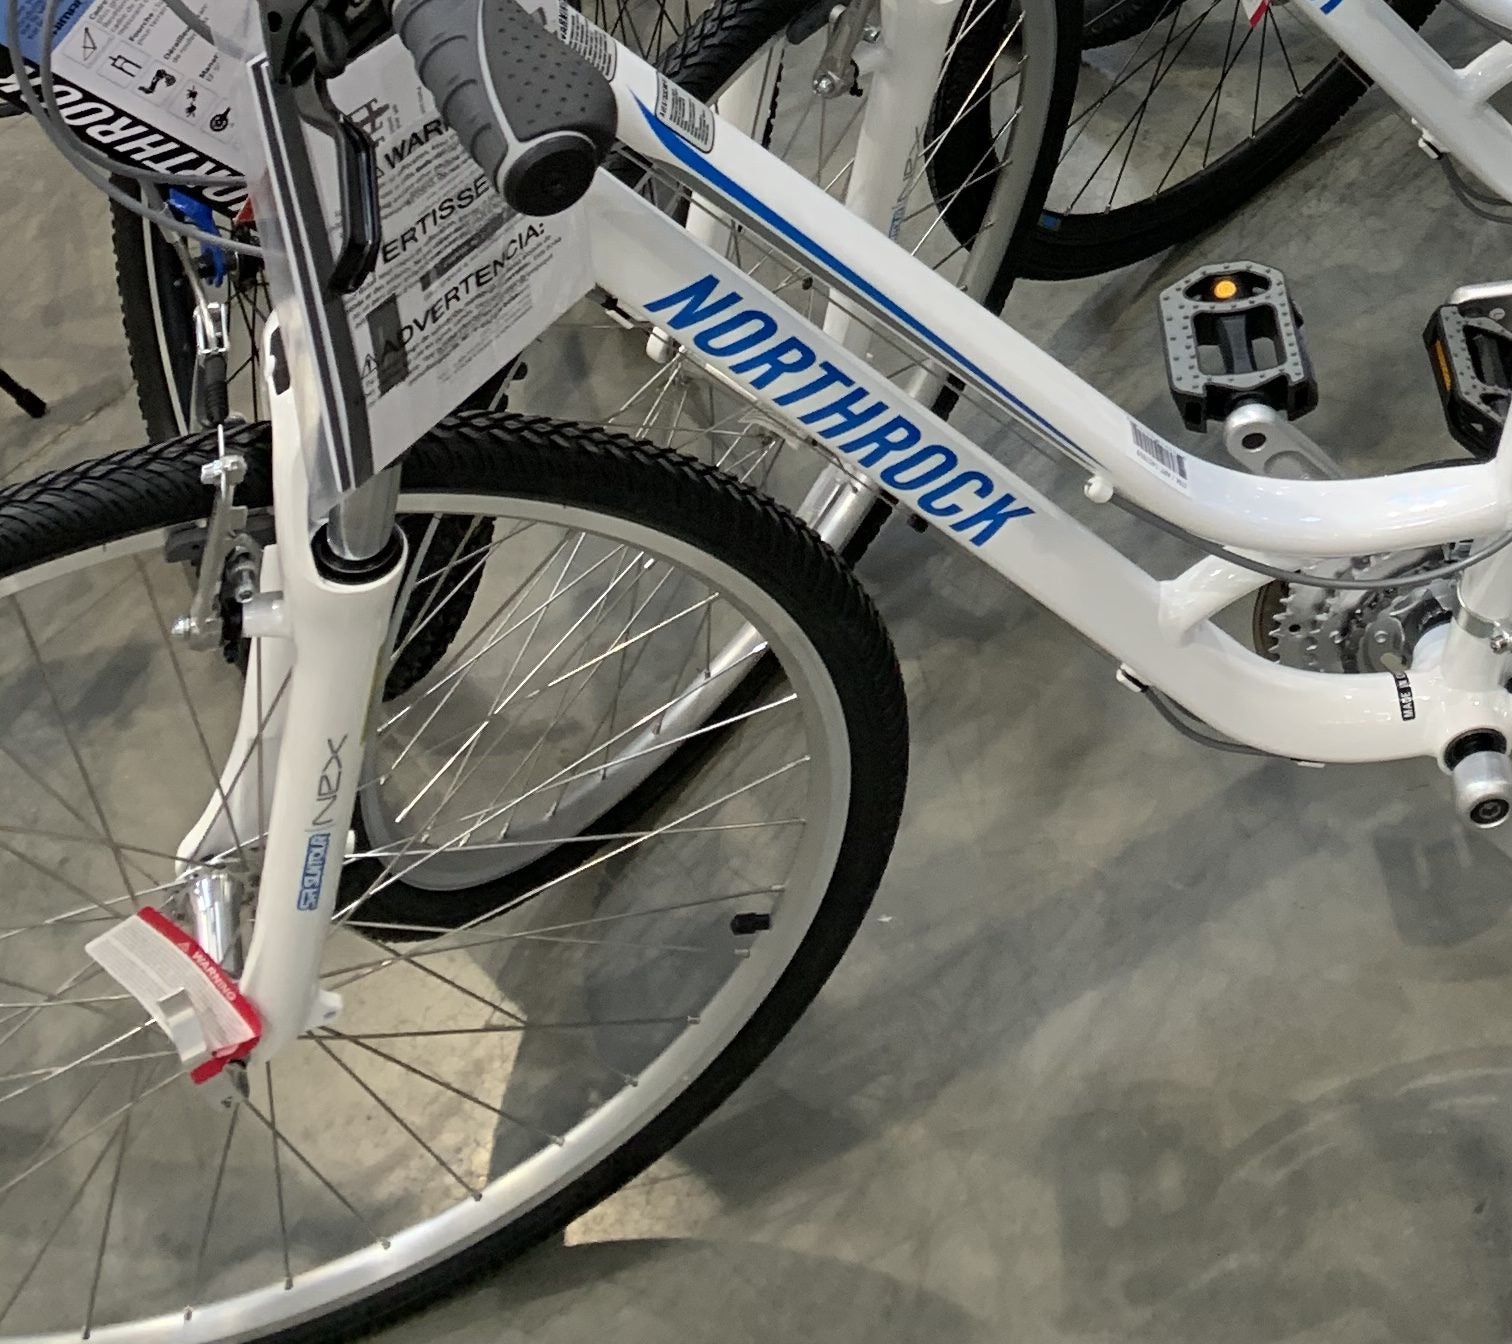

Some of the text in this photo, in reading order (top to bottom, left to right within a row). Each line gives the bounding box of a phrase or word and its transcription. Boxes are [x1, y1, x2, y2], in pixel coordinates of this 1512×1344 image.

[381, 171, 491, 265] ERTISSE
[380, 220, 546, 354] ADVERTENCIA:
[643, 272, 1038, 550] NORTHROCK
[190, 949, 238, 1002] WARNING
